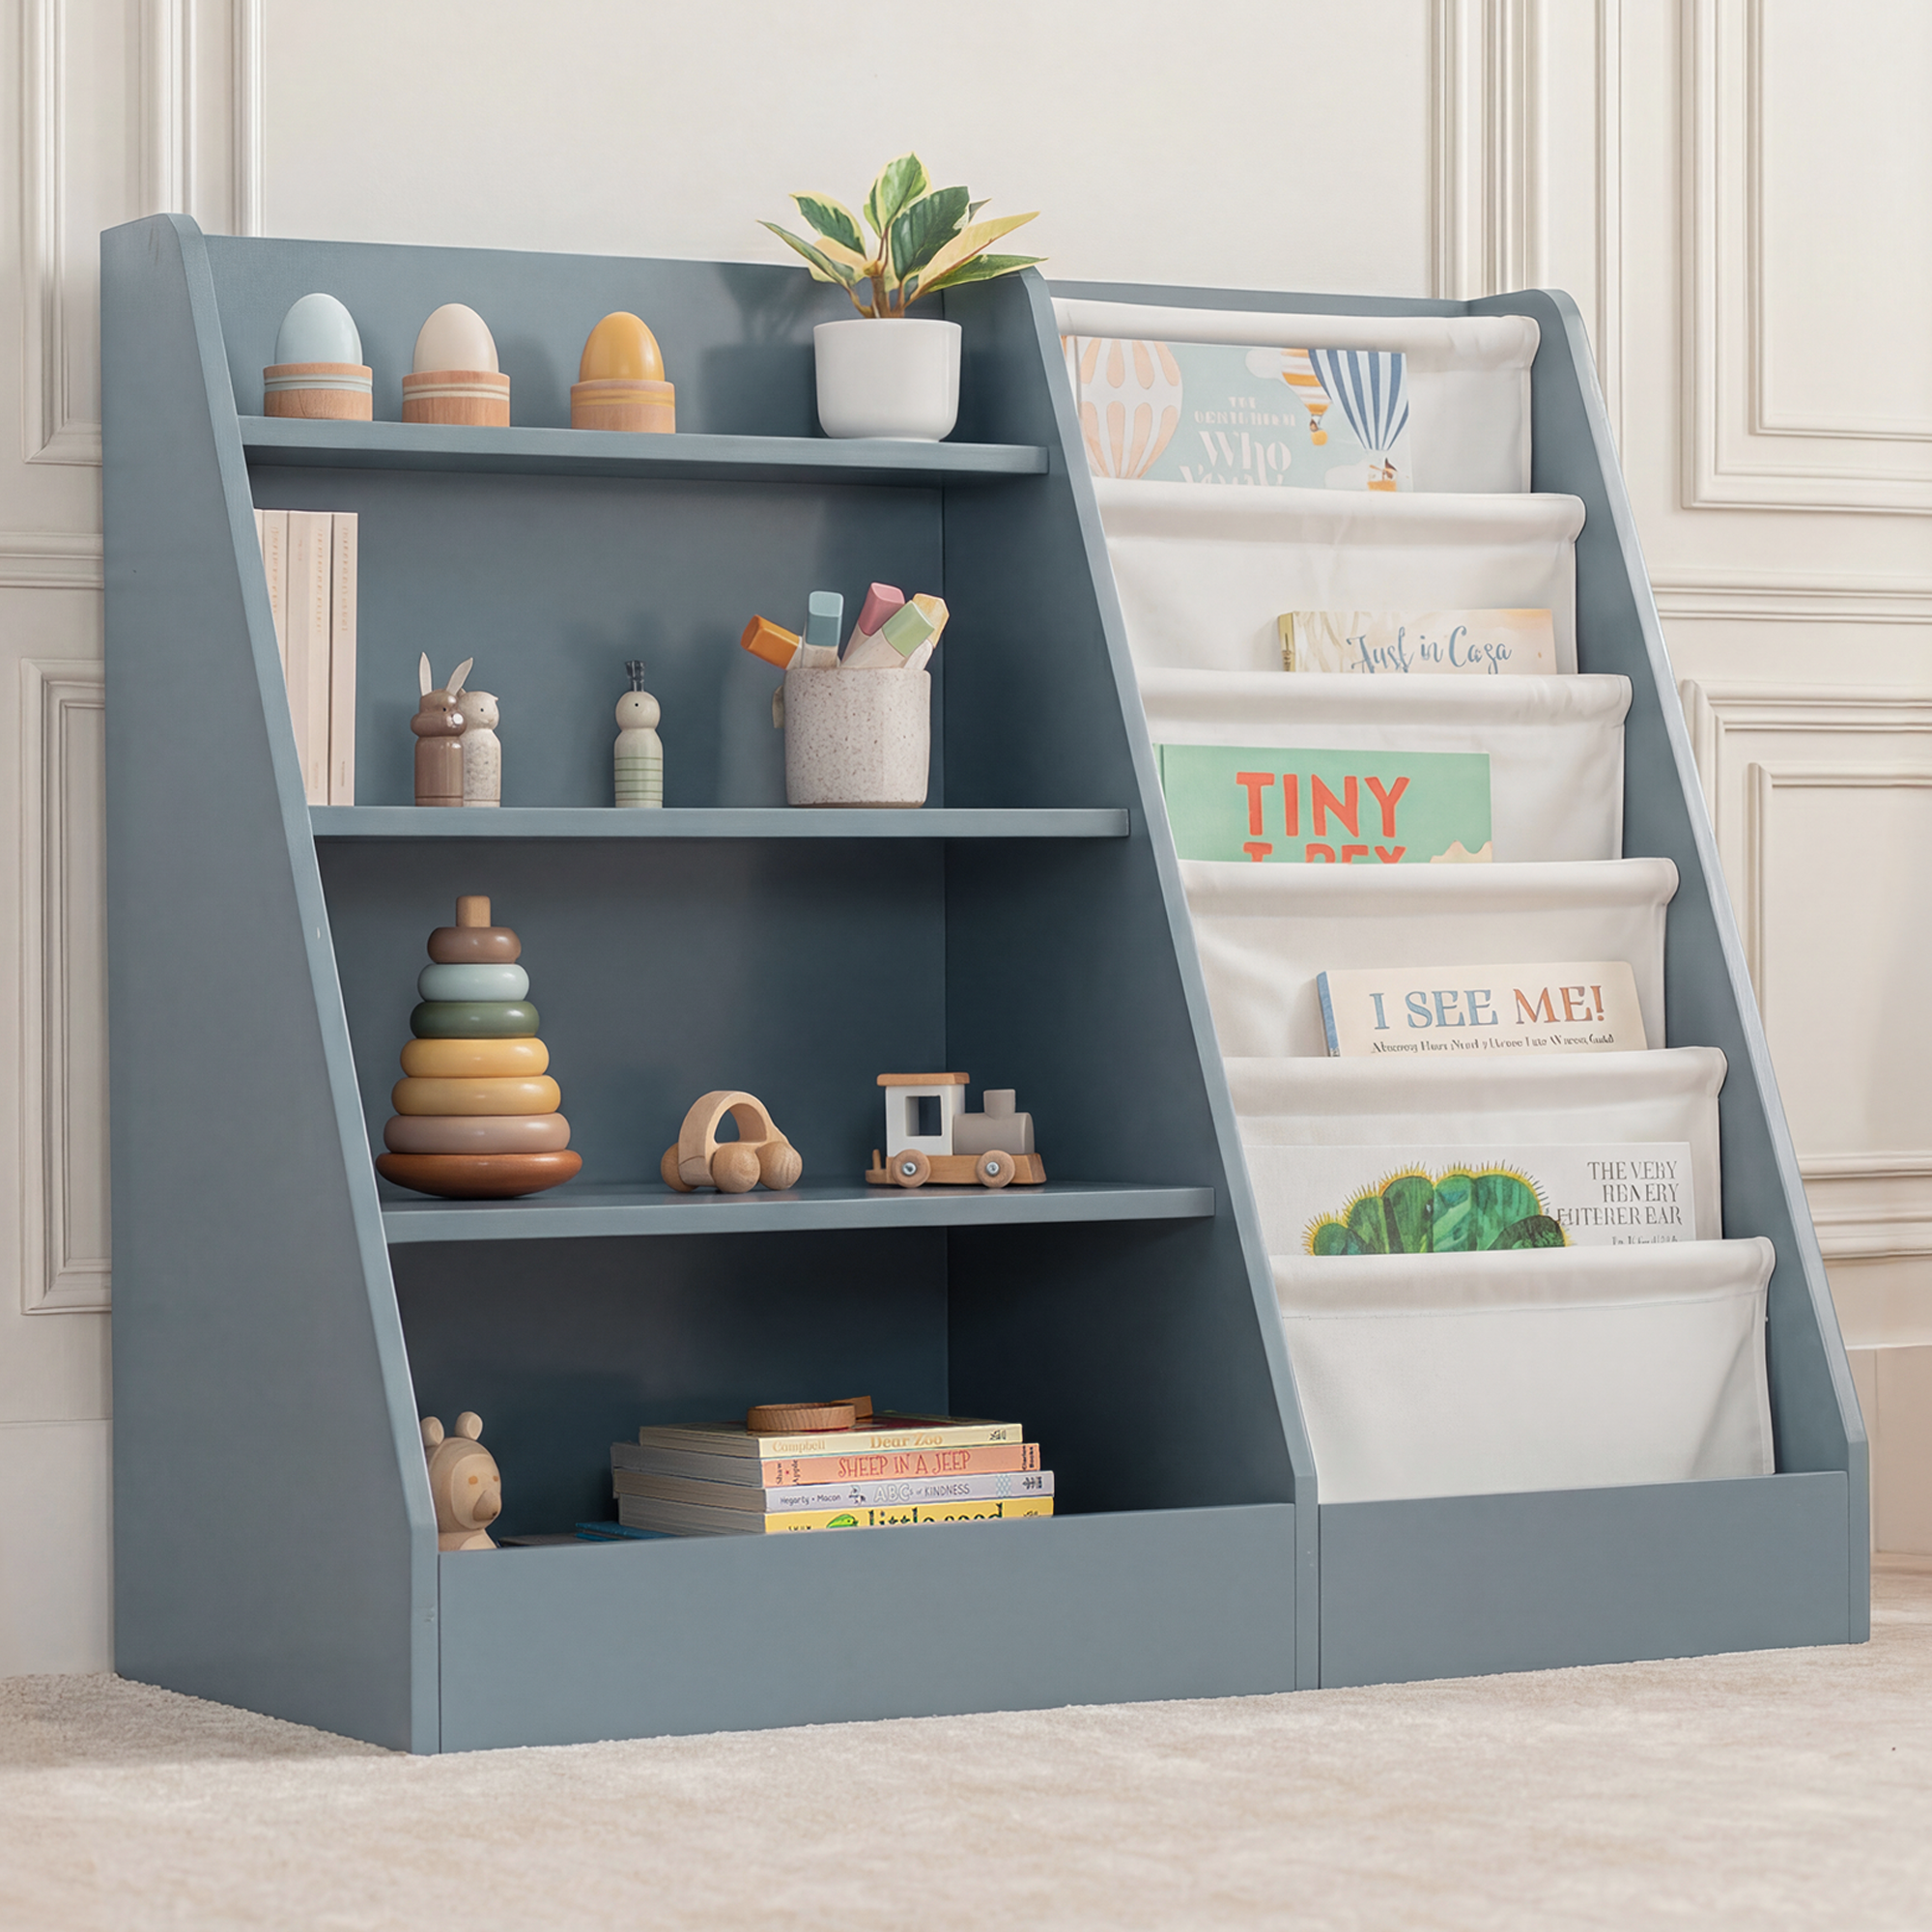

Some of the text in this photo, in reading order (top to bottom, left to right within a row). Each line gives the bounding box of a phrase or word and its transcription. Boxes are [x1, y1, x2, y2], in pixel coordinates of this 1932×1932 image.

[1420, 635, 1444, 663] in
[1236, 772, 1410, 838] TINY
[1369, 985, 1605, 1030] I SEE ME!
[1587, 1161, 1628, 1179] THE
[773, 1439, 826, 1453] Campbell
[870, 1433, 943, 1449] Dear Zoo
[838, 1450, 971, 1478] SHEEP IN A JEEP
[924, 1483, 971, 1497] KINDNESS
[780, 1493, 841, 1506] Hegarty Macon
